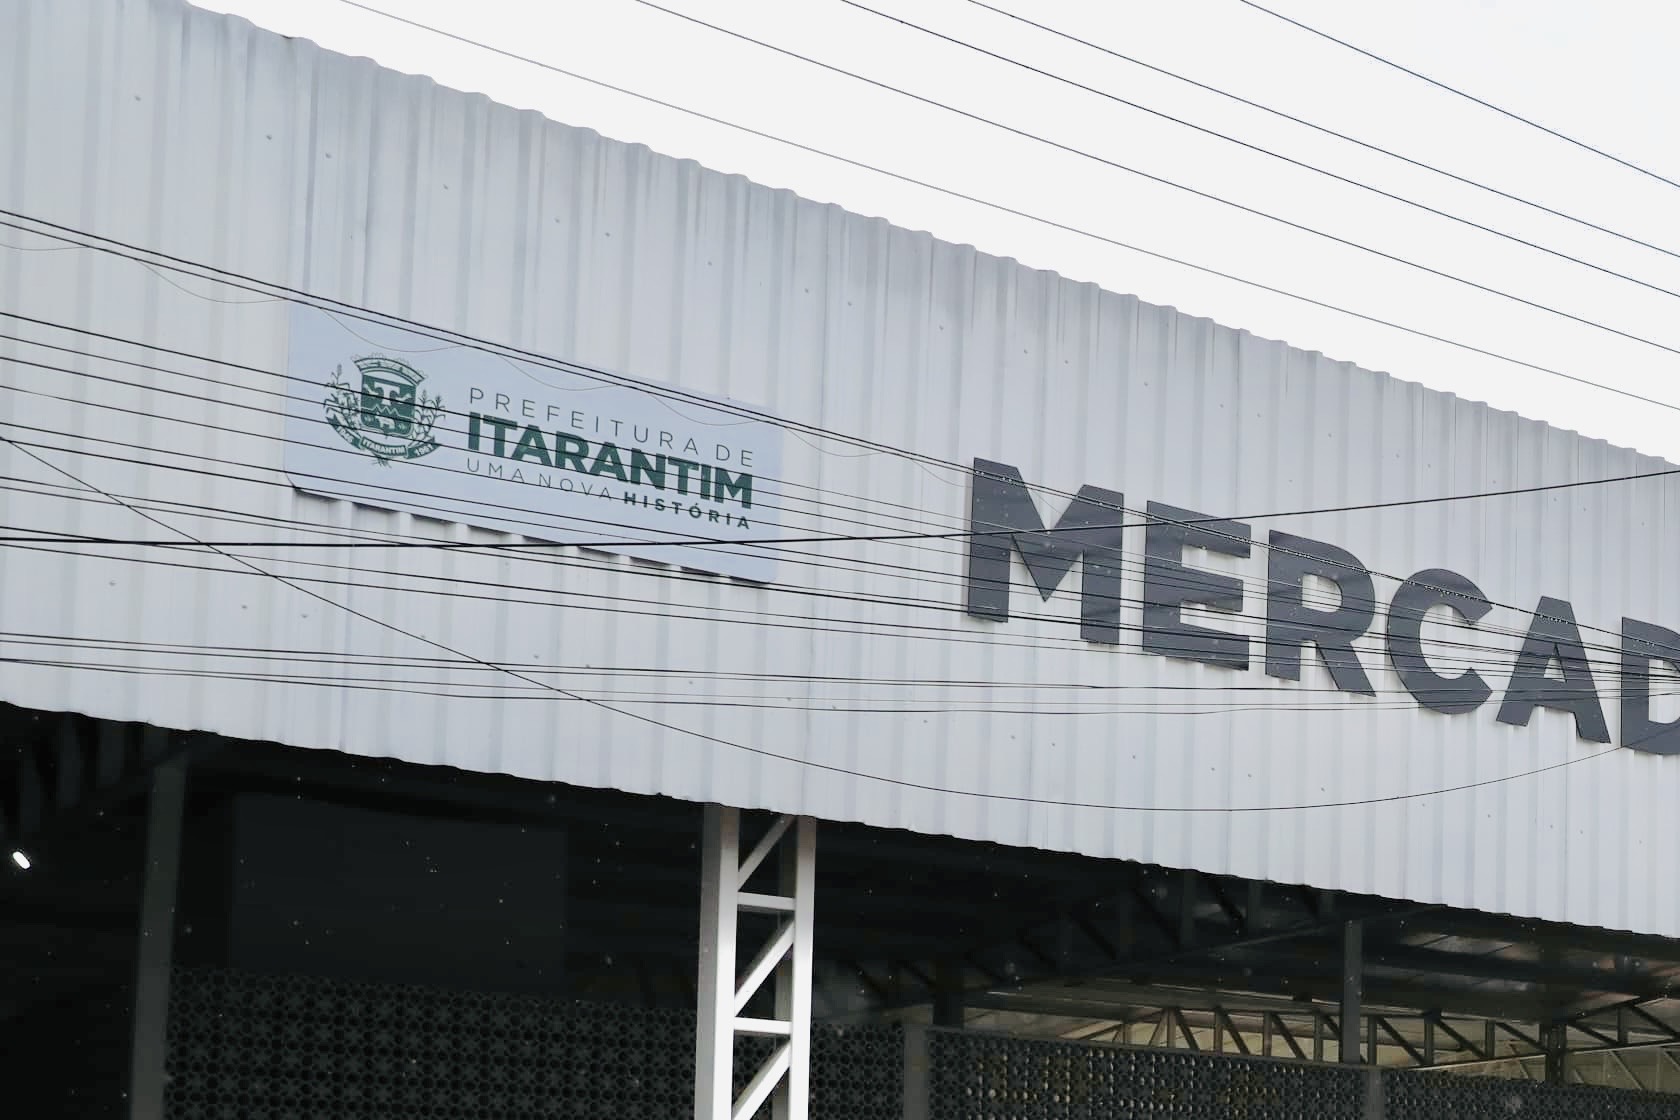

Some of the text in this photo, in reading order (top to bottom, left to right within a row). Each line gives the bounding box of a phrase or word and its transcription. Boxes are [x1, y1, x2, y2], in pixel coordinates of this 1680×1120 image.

[467, 411, 753, 510] ITARANTIM
[469, 387, 753, 468] PREFEITURA DE
[466, 457, 751, 530] UMA NOVA HISTÓRIA
